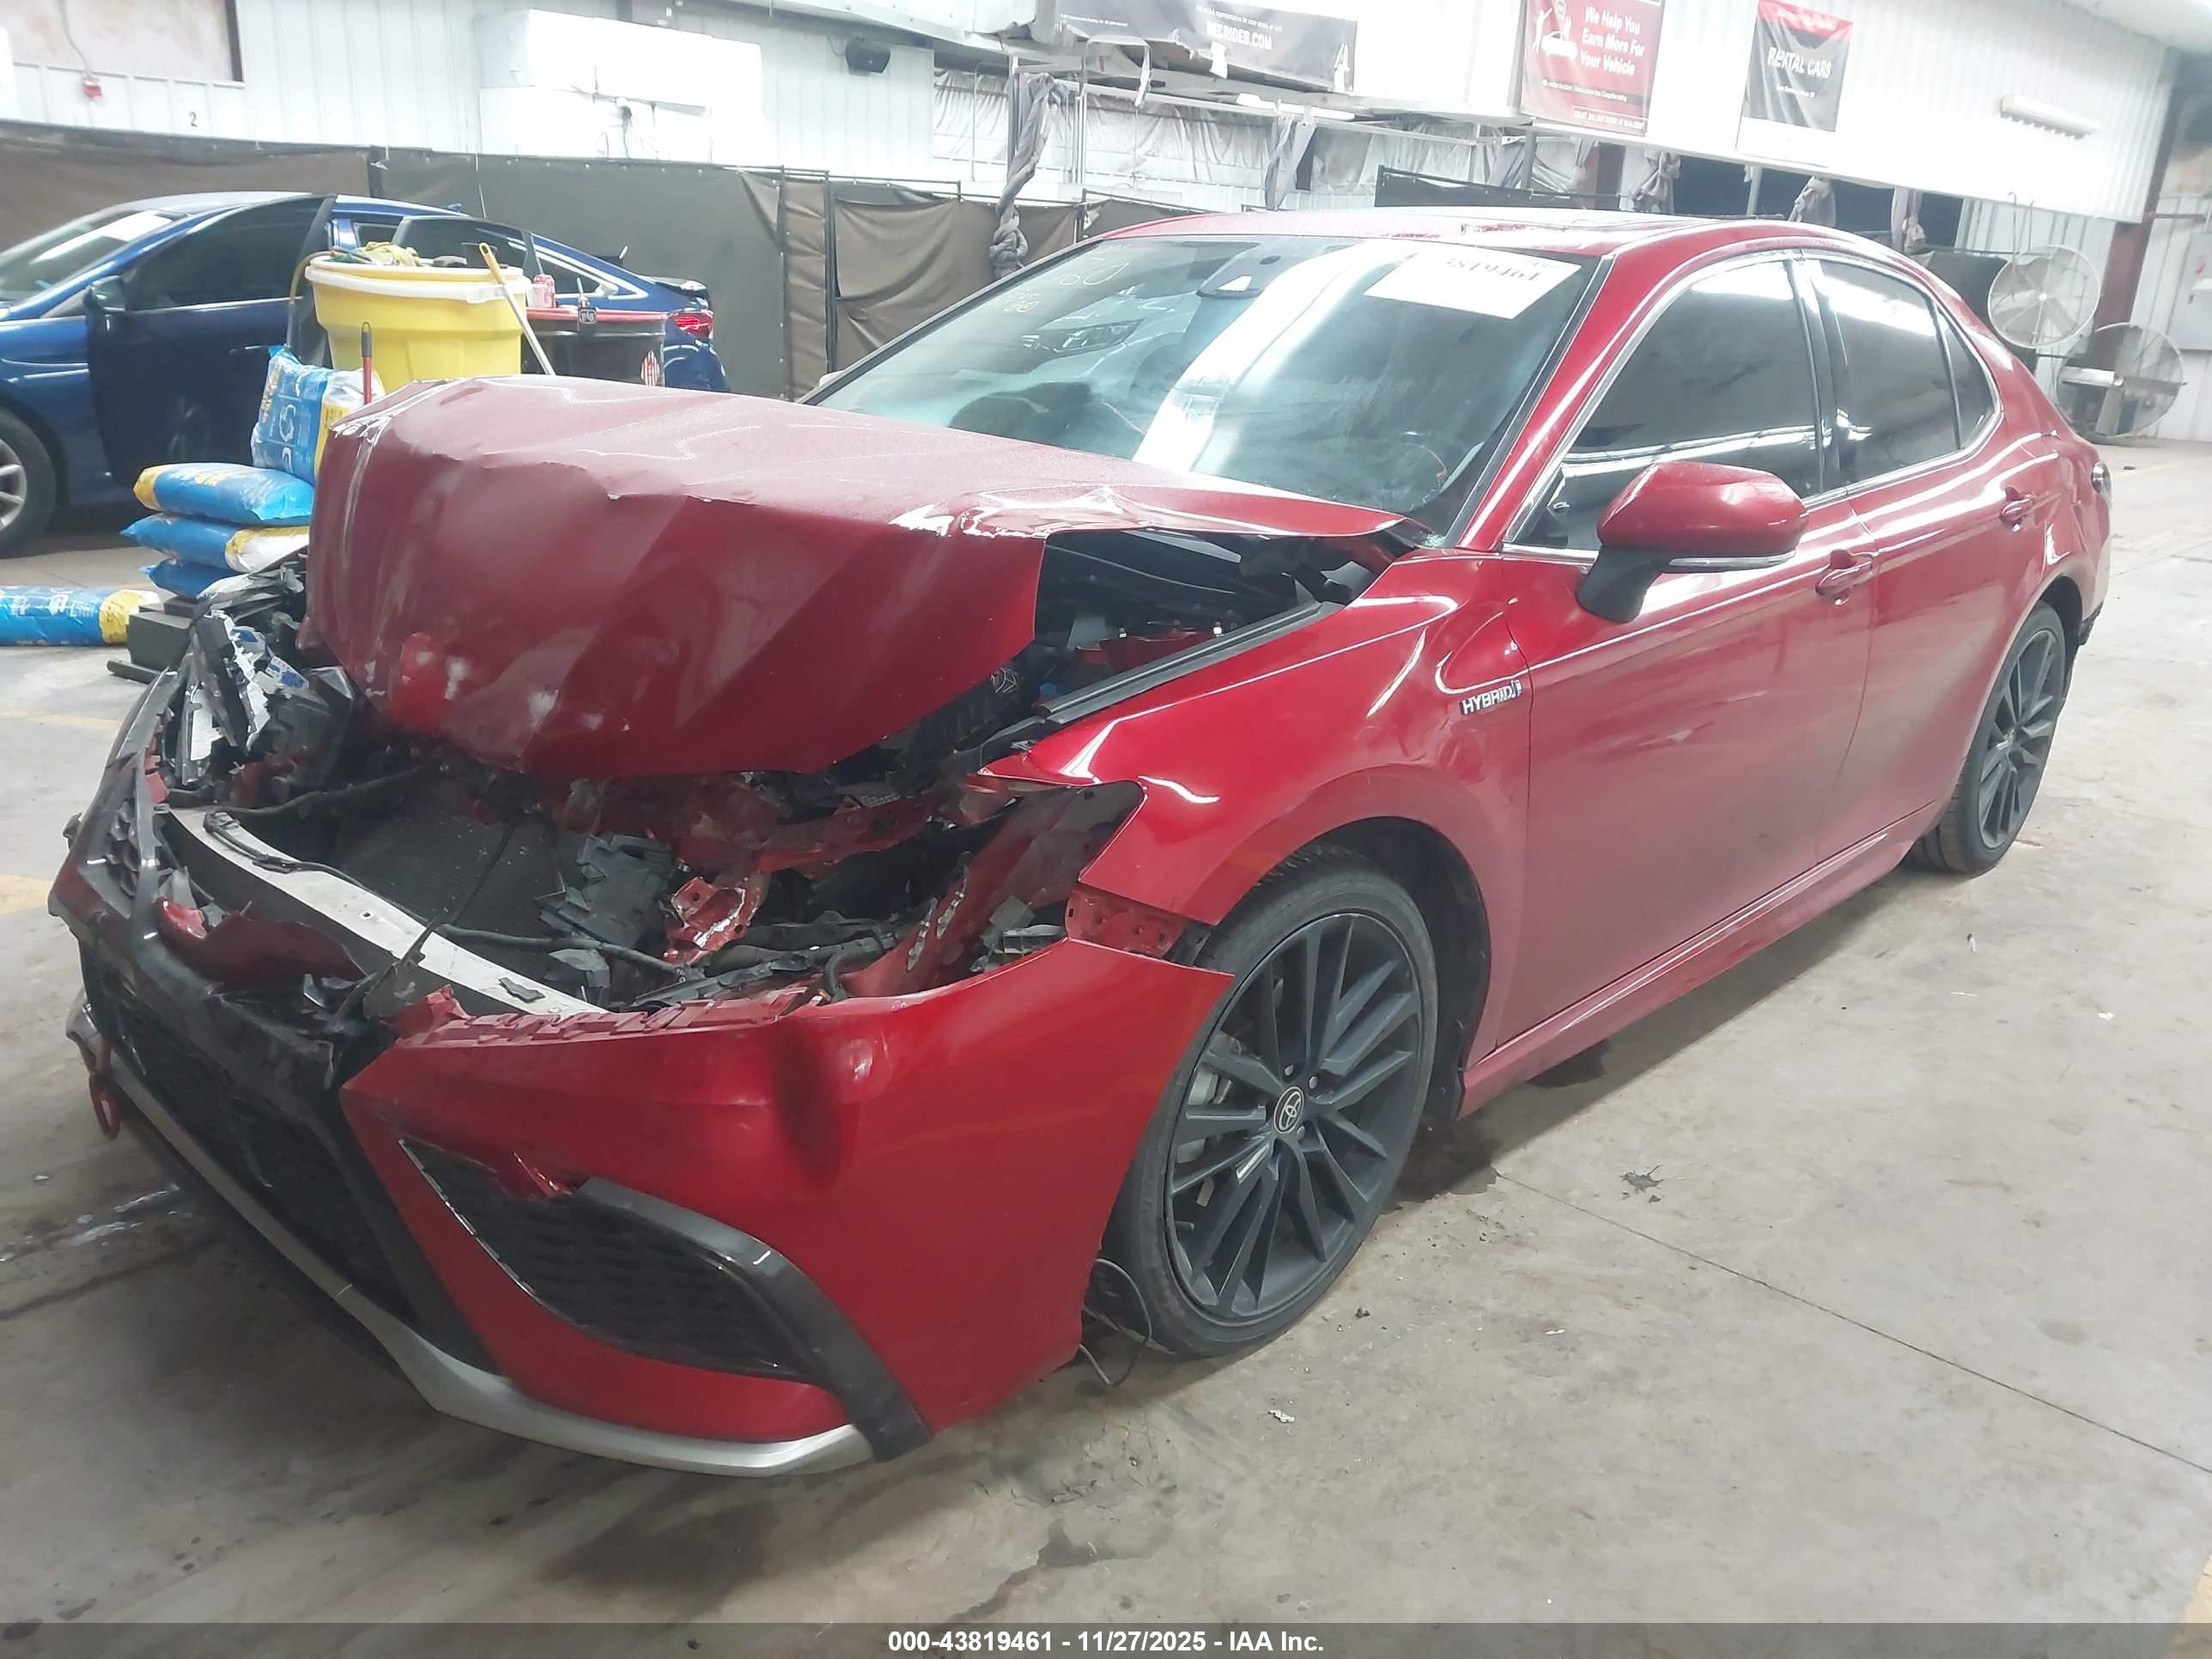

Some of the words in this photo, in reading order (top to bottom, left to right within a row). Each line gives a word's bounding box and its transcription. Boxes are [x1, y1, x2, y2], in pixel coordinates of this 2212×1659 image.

[1584, 5, 1600, 24] We
[1601, 9, 1623, 33] Help
[1625, 15, 1641, 34] You
[1582, 27, 1603, 47] Earn
[1605, 33, 1628, 53] More
[1630, 39, 1645, 57] For
[1580, 49, 1601, 69] Your
[1603, 54, 1636, 76] Vehicle
[1807, 59, 1832, 79] CARS
[188, 111, 198, 127] 2
[1462, 685, 1513, 715] HYBRID
